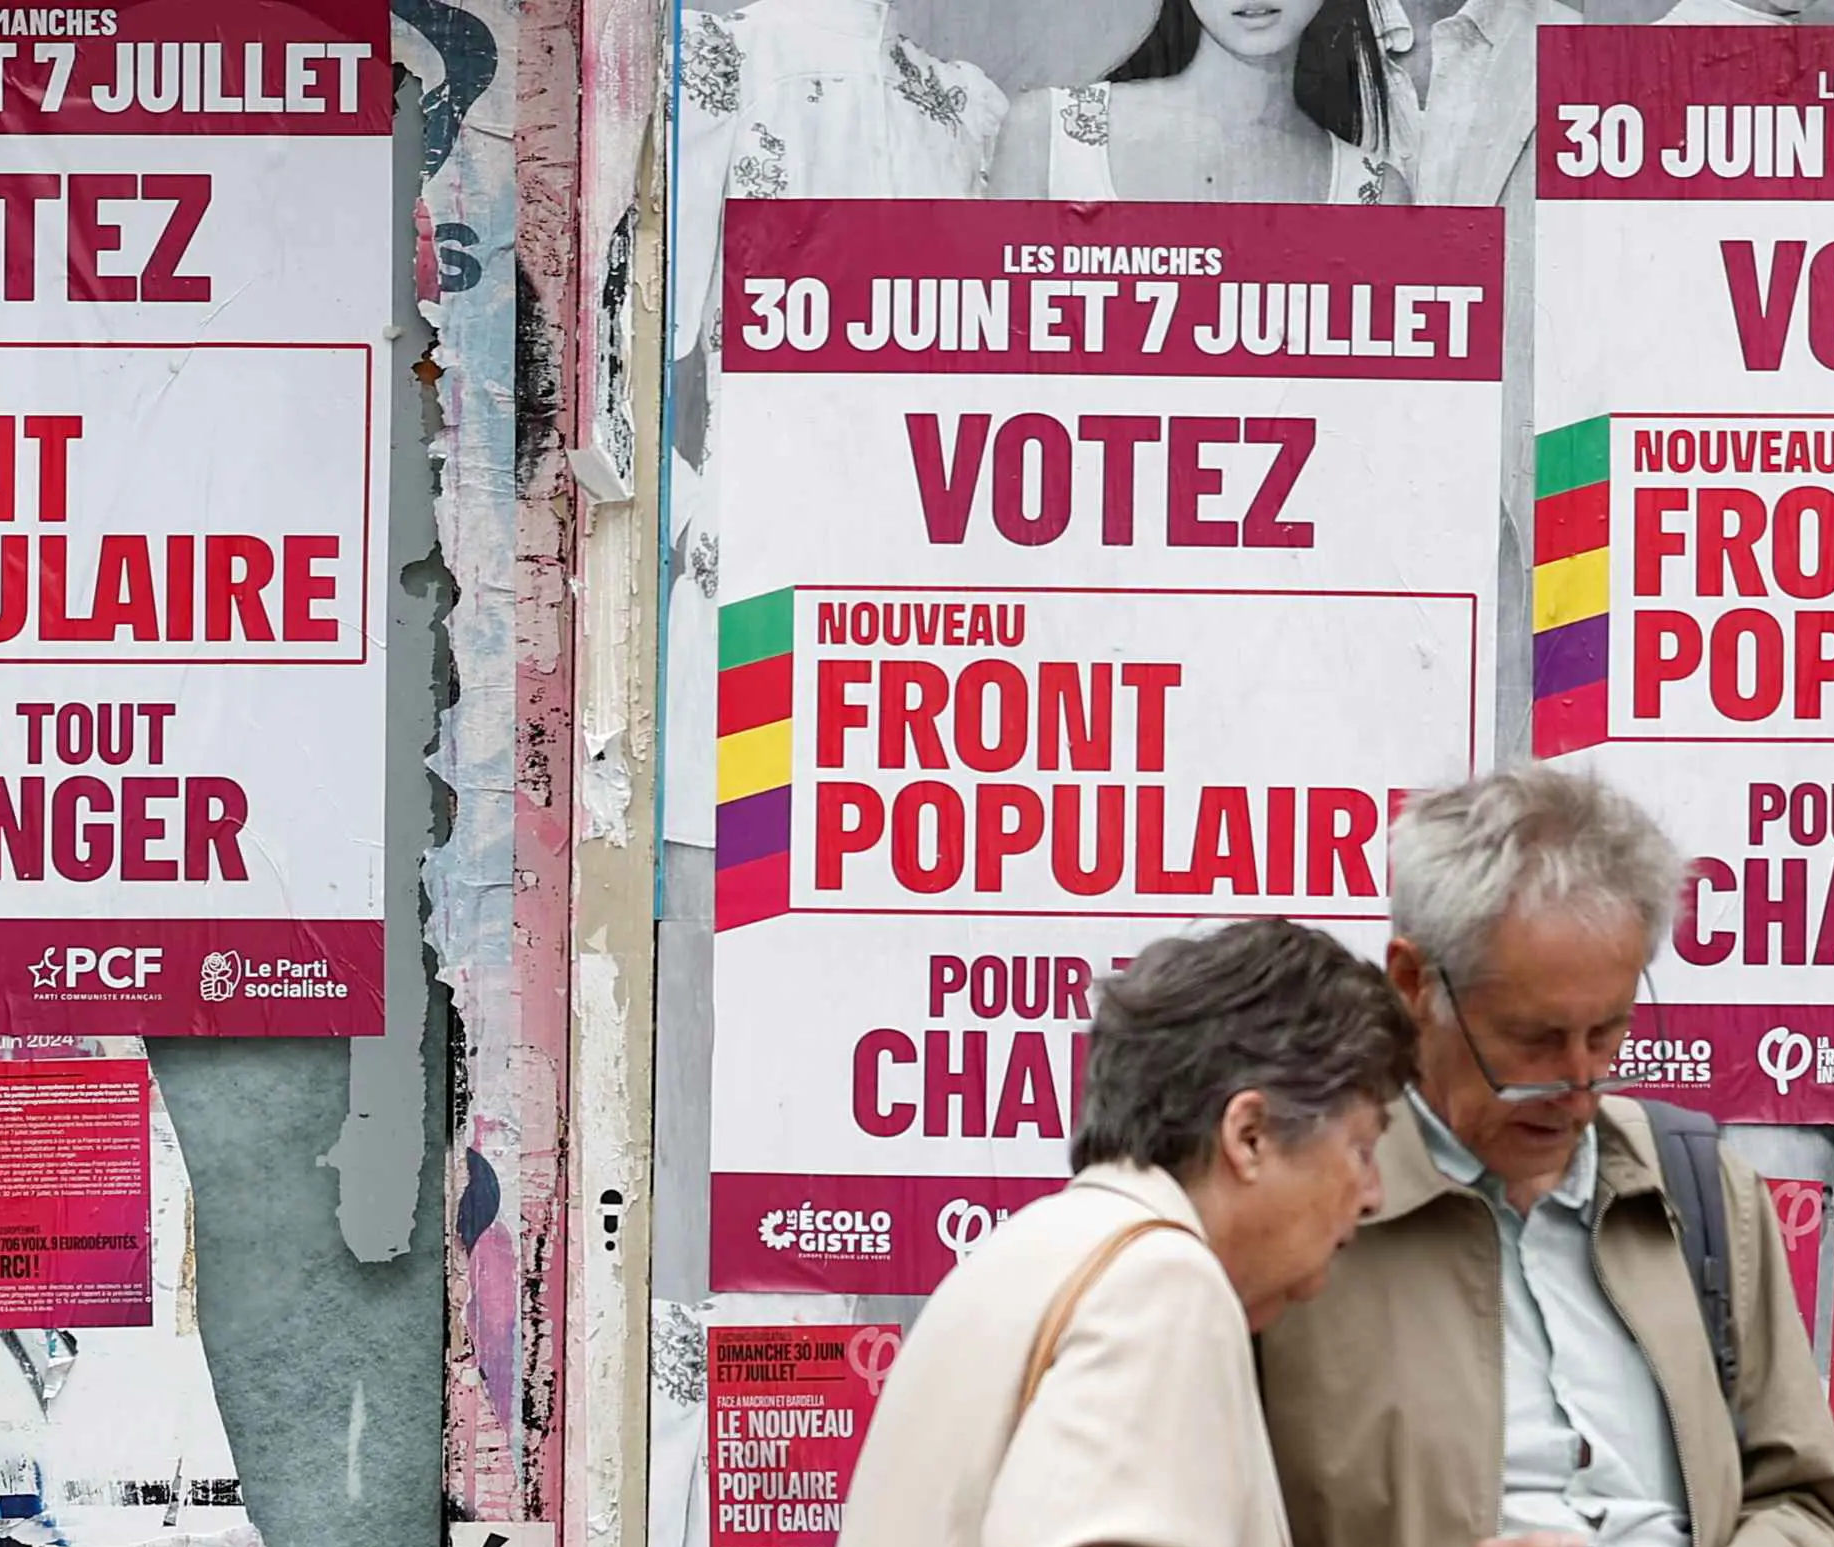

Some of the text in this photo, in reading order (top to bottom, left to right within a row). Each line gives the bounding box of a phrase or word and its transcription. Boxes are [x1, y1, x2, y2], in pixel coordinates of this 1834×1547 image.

[21, 42, 75, 113] 7
[92, 42, 372, 115] JUILLET
[1558, 104, 1643, 178] 30
[1661, 105, 1824, 179] JUIN
[1004, 245, 1222, 276] LES DIMANCHES
[742, 278, 1483, 359] 30 JUIN ET 7 JUILLET
[904, 413, 1316, 549] VOTEZ
[818, 602, 1025, 648] NOUVEAU
[16, 702, 177, 766] TOUT
[816, 658, 1182, 773] FRONT
[814, 781, 1403, 899] POPULAIR
[66, 947, 163, 988] PCF
[245, 958, 328, 979] Le Parti
[245, 978, 348, 1000] socialiste
[929, 955, 1092, 1020] POUR
